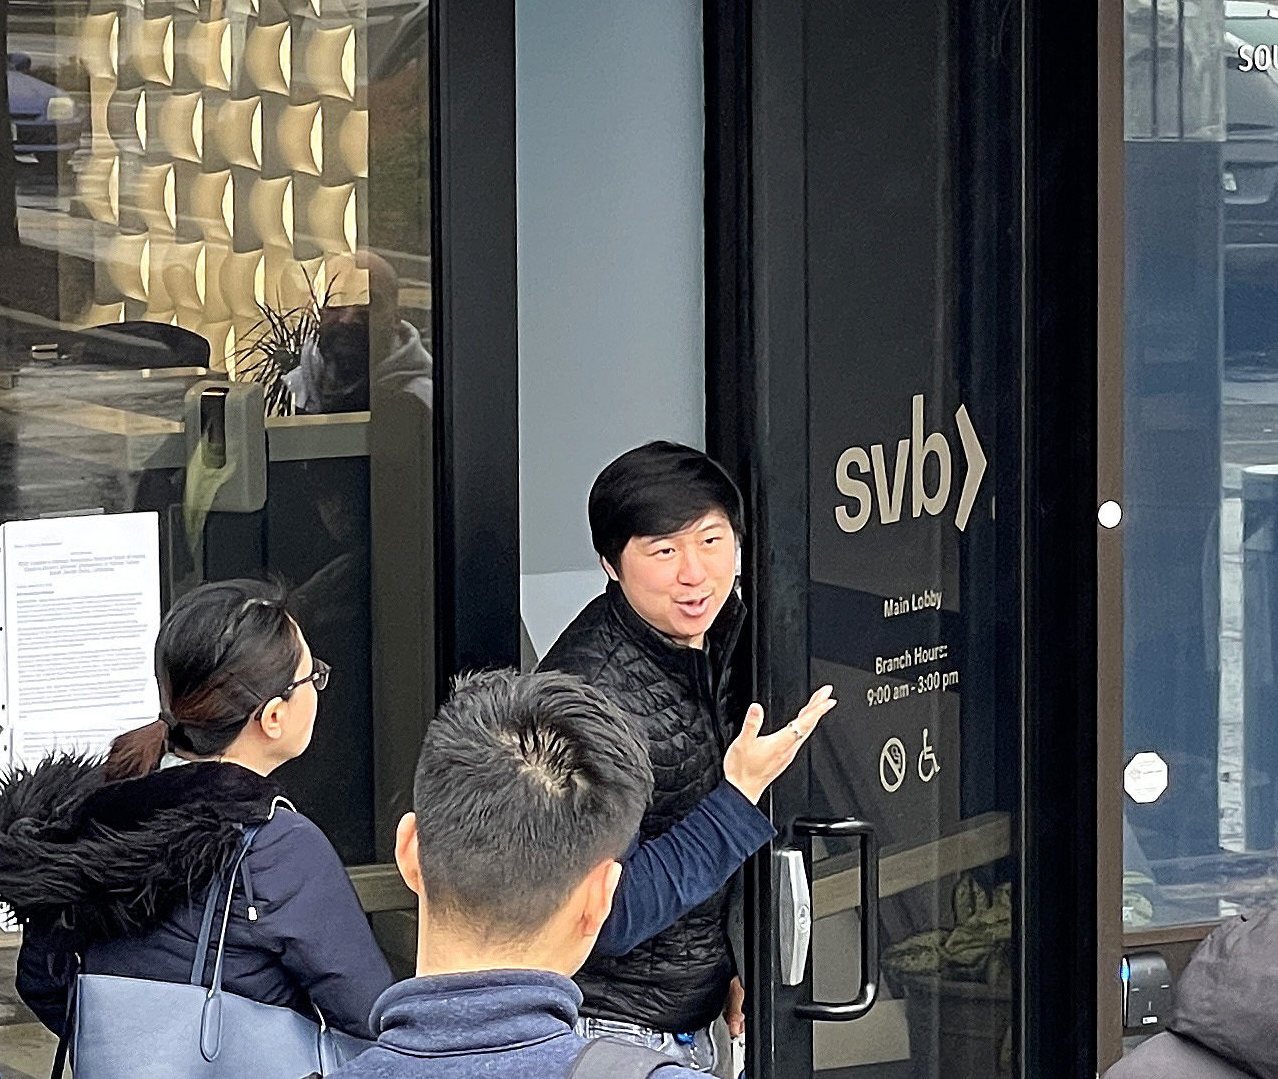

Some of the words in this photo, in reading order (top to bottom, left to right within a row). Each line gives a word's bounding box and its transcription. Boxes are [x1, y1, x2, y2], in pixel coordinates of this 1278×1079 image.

[883, 596, 910, 619] Main
[911, 589, 943, 611] Lobby
[875, 649, 912, 675] Branch
[866, 684, 892, 707] 9:00
[892, 684, 910, 700] am
[917, 671, 940, 694] 3:00
[942, 670, 959, 692] pm
